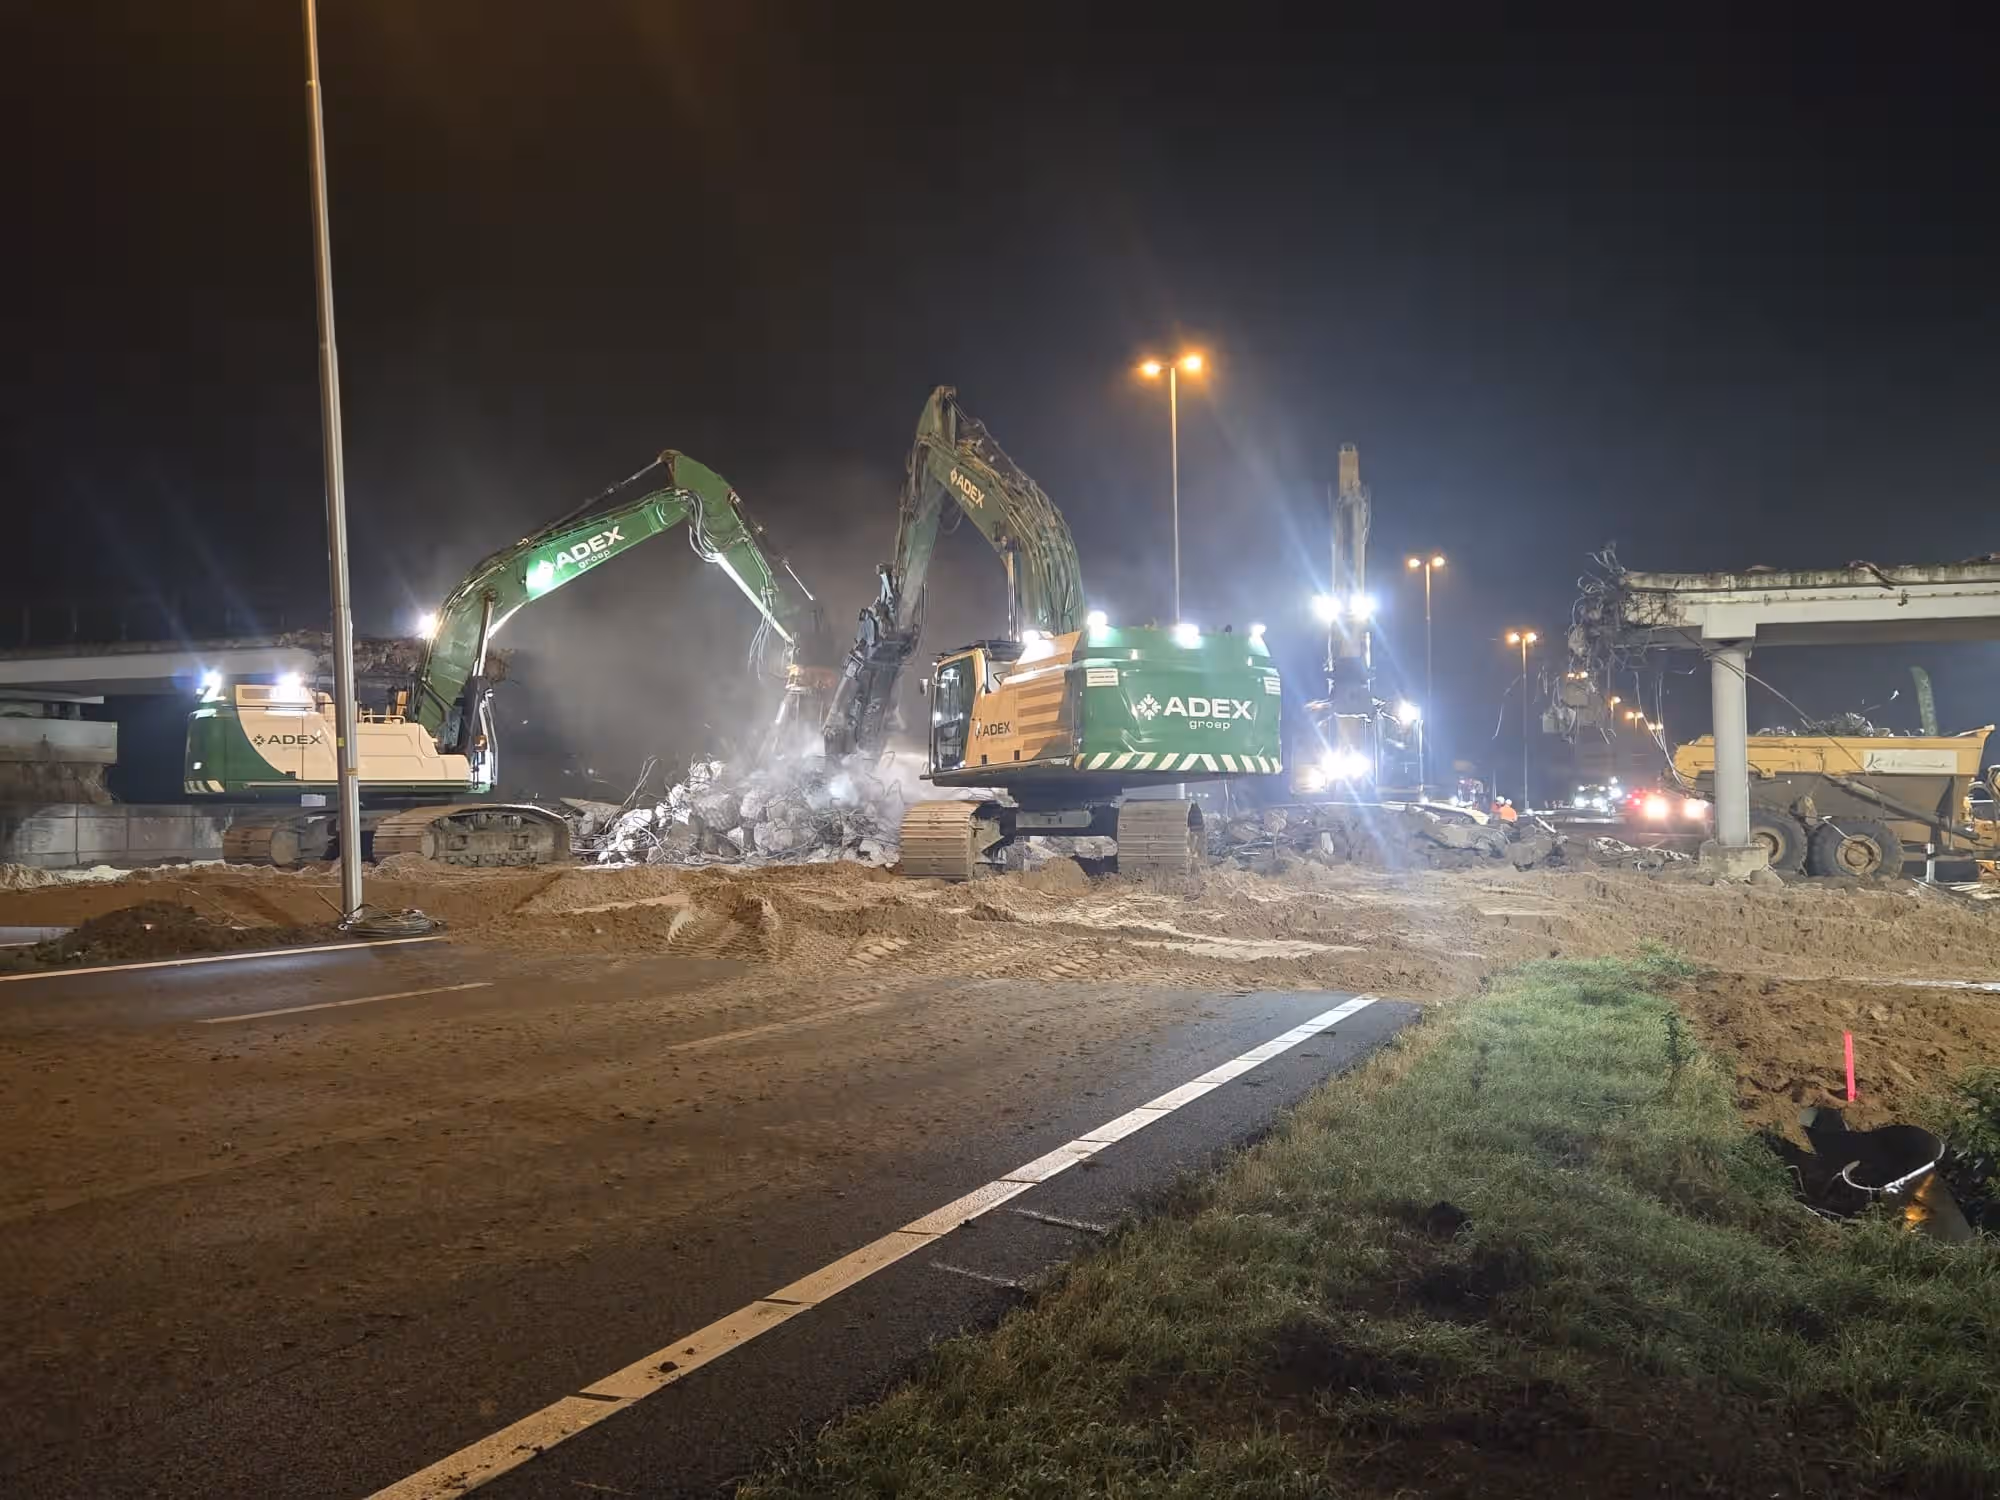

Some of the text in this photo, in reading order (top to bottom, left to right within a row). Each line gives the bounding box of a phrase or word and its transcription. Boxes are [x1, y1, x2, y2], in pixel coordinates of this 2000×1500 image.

[956, 474, 985, 509] ADEX
[556, 525, 625, 570] ADEX
[1163, 696, 1253, 720] ADEX
[267, 734, 322, 744] ADEX
[983, 721, 1011, 736] ADEX
